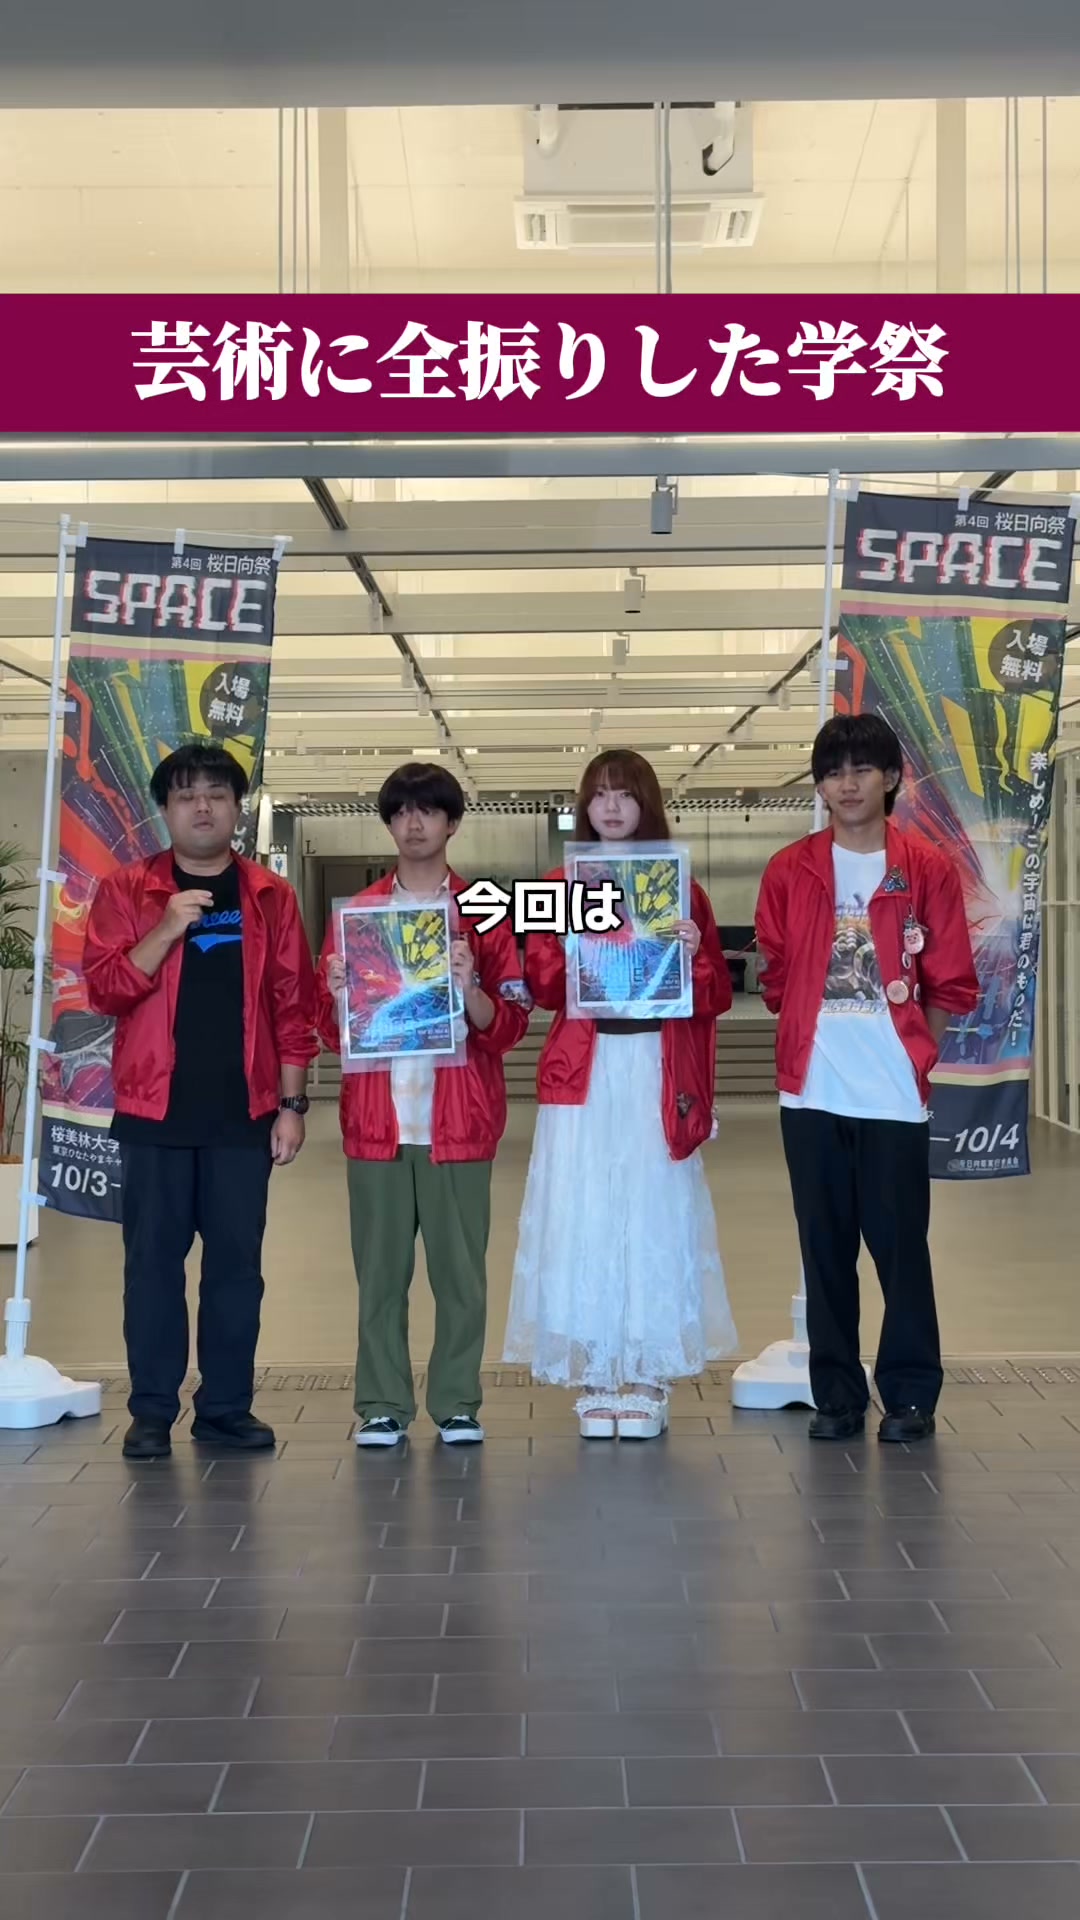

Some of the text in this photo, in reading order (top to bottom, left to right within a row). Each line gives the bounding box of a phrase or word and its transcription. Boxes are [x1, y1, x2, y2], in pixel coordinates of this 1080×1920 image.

[955, 512, 1066, 535] 第4回 桜日向祭
[171, 553, 271, 575] 第4回 桜日向祭
[857, 528, 1062, 591] SPACE
[84, 569, 267, 633] SPACE
[1006, 629, 1048, 657] 入場
[1000, 655, 1043, 683] 無料
[215, 672, 250, 700] 入場
[208, 698, 244, 727] 無料
[51, 1125, 120, 1153] 桜美林大学
